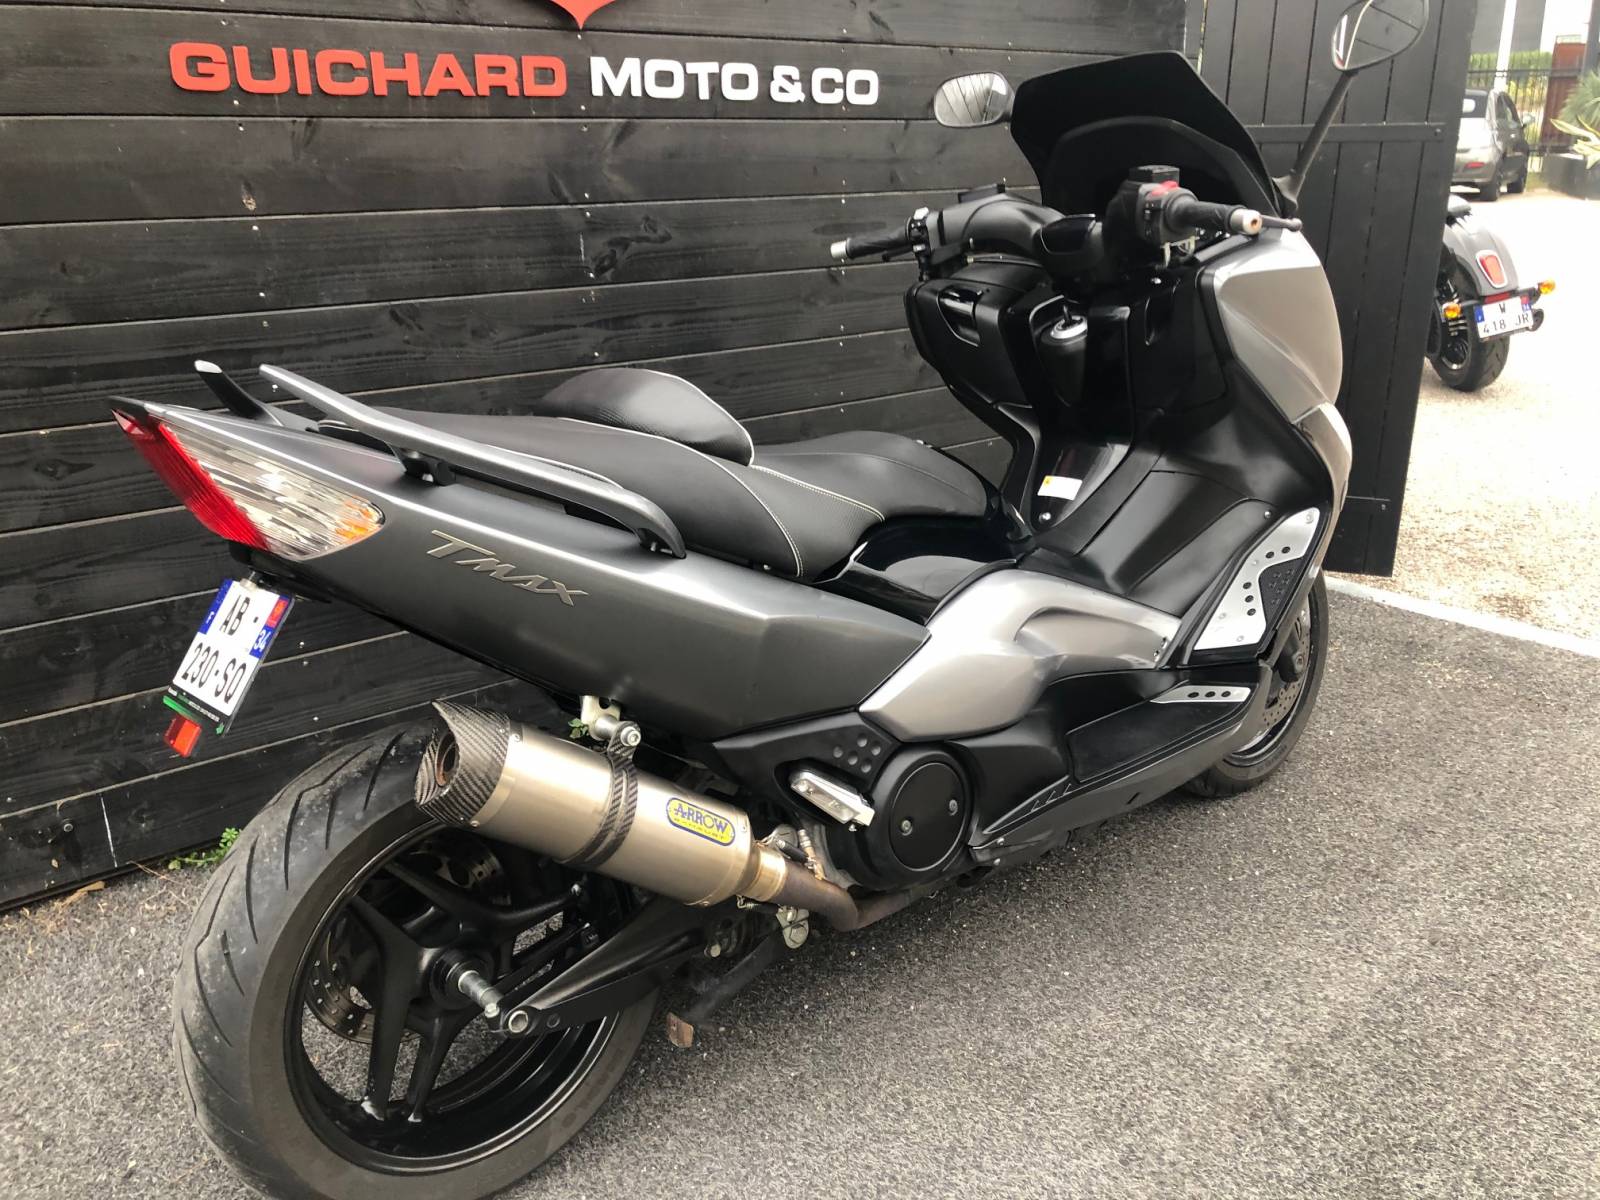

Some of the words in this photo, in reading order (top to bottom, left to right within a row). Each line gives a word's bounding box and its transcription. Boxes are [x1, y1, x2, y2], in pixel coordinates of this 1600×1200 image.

[169, 42, 567, 97] GUICHARD
[427, 530, 589, 606] TMAX
[673, 803, 728, 833] ARROW
